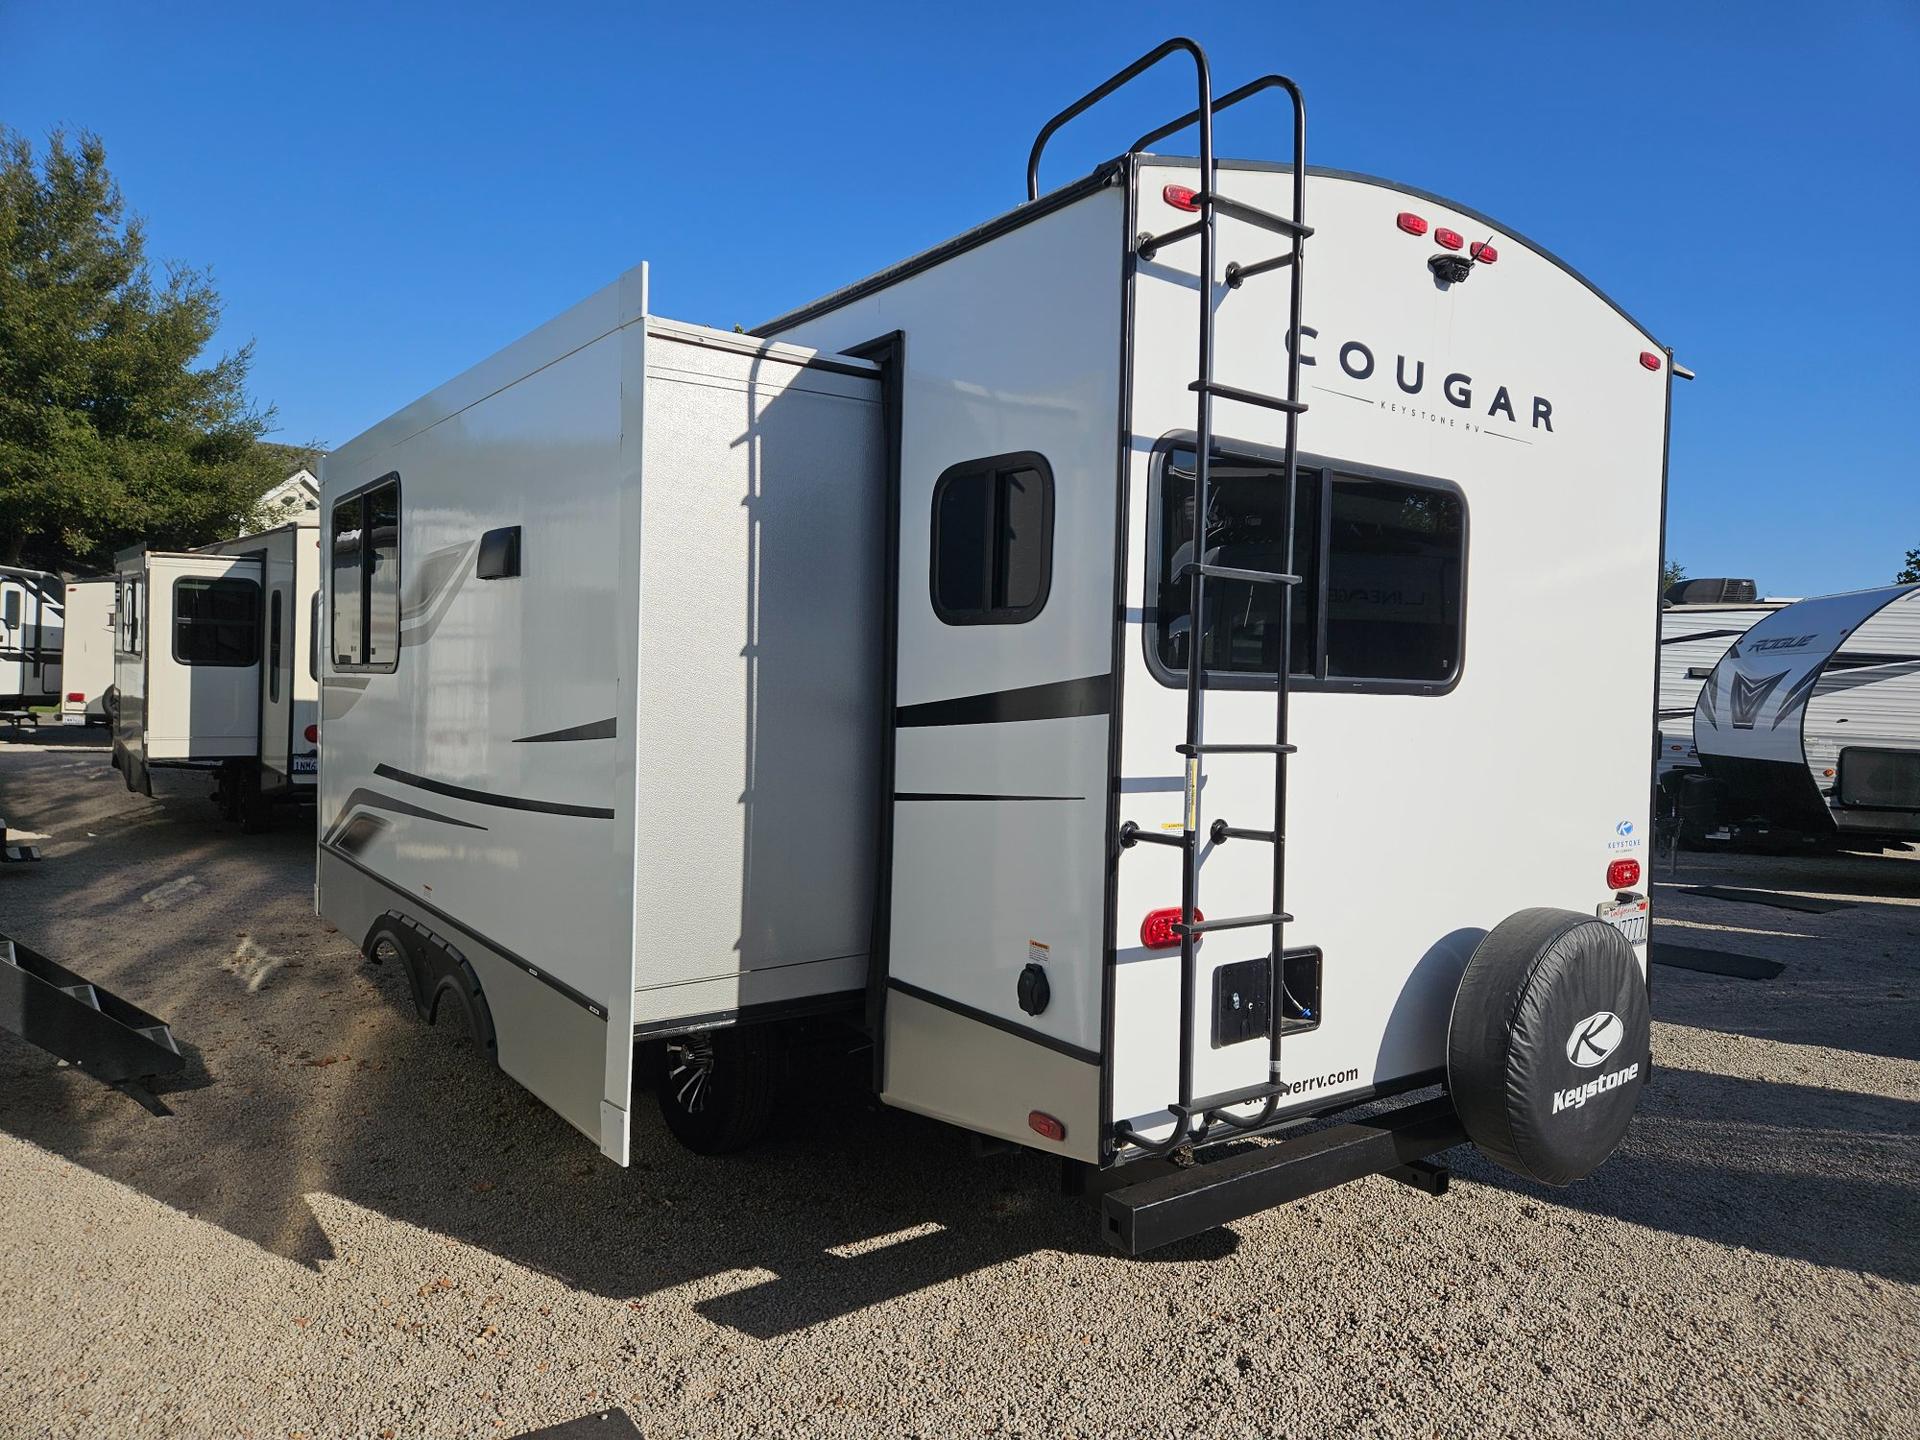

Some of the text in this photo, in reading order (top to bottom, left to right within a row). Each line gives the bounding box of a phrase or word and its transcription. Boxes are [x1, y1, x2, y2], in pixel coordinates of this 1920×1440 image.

[1285, 325, 1554, 433] COUGAR
[1380, 400, 1480, 433] KEYSTONE RV
[1747, 634, 1819, 652] ROGUE
[1608, 838, 1641, 849] KEYSTONE
[1552, 1062, 1639, 1115] Keystone
